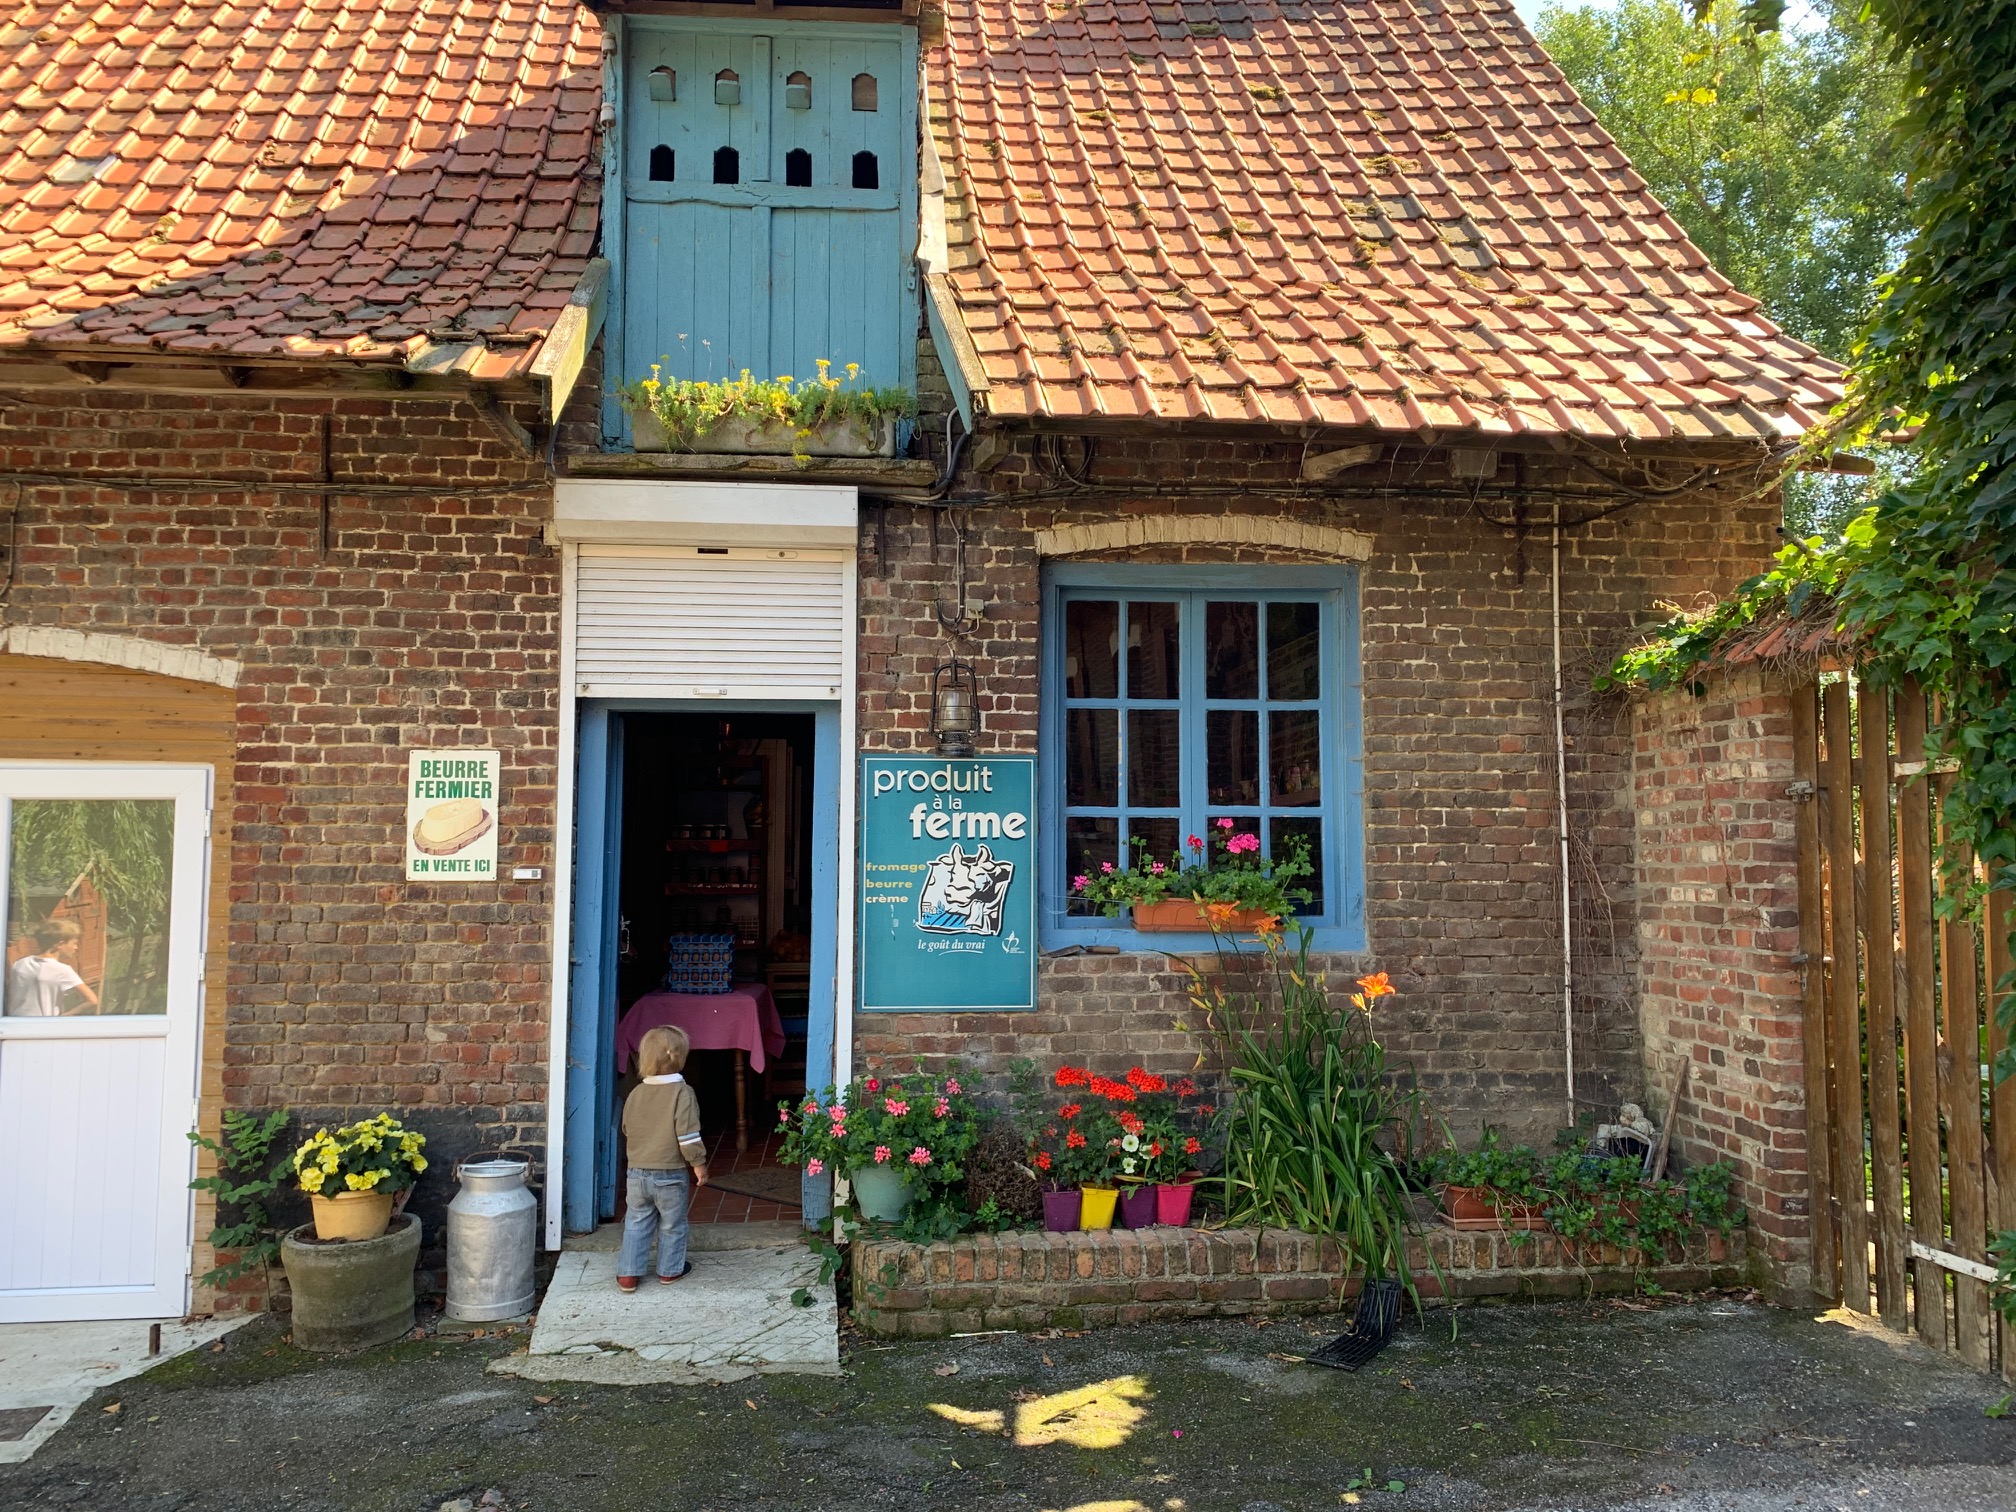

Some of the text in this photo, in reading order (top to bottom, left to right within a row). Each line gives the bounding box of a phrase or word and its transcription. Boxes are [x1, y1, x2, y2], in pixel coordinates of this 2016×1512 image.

[420, 760, 488, 778] BEURRE
[874, 764, 993, 797] produit
[415, 780, 492, 799] FERMIER
[932, 794, 962, 810] à la
[909, 802, 1027, 839] ferme
[413, 859, 491, 872] EN VENTE ICI
[866, 862, 927, 873] fromage
[866, 879, 913, 888] beurre
[866, 893, 909, 903] crème
[917, 938, 986, 953] le goût du vrai
